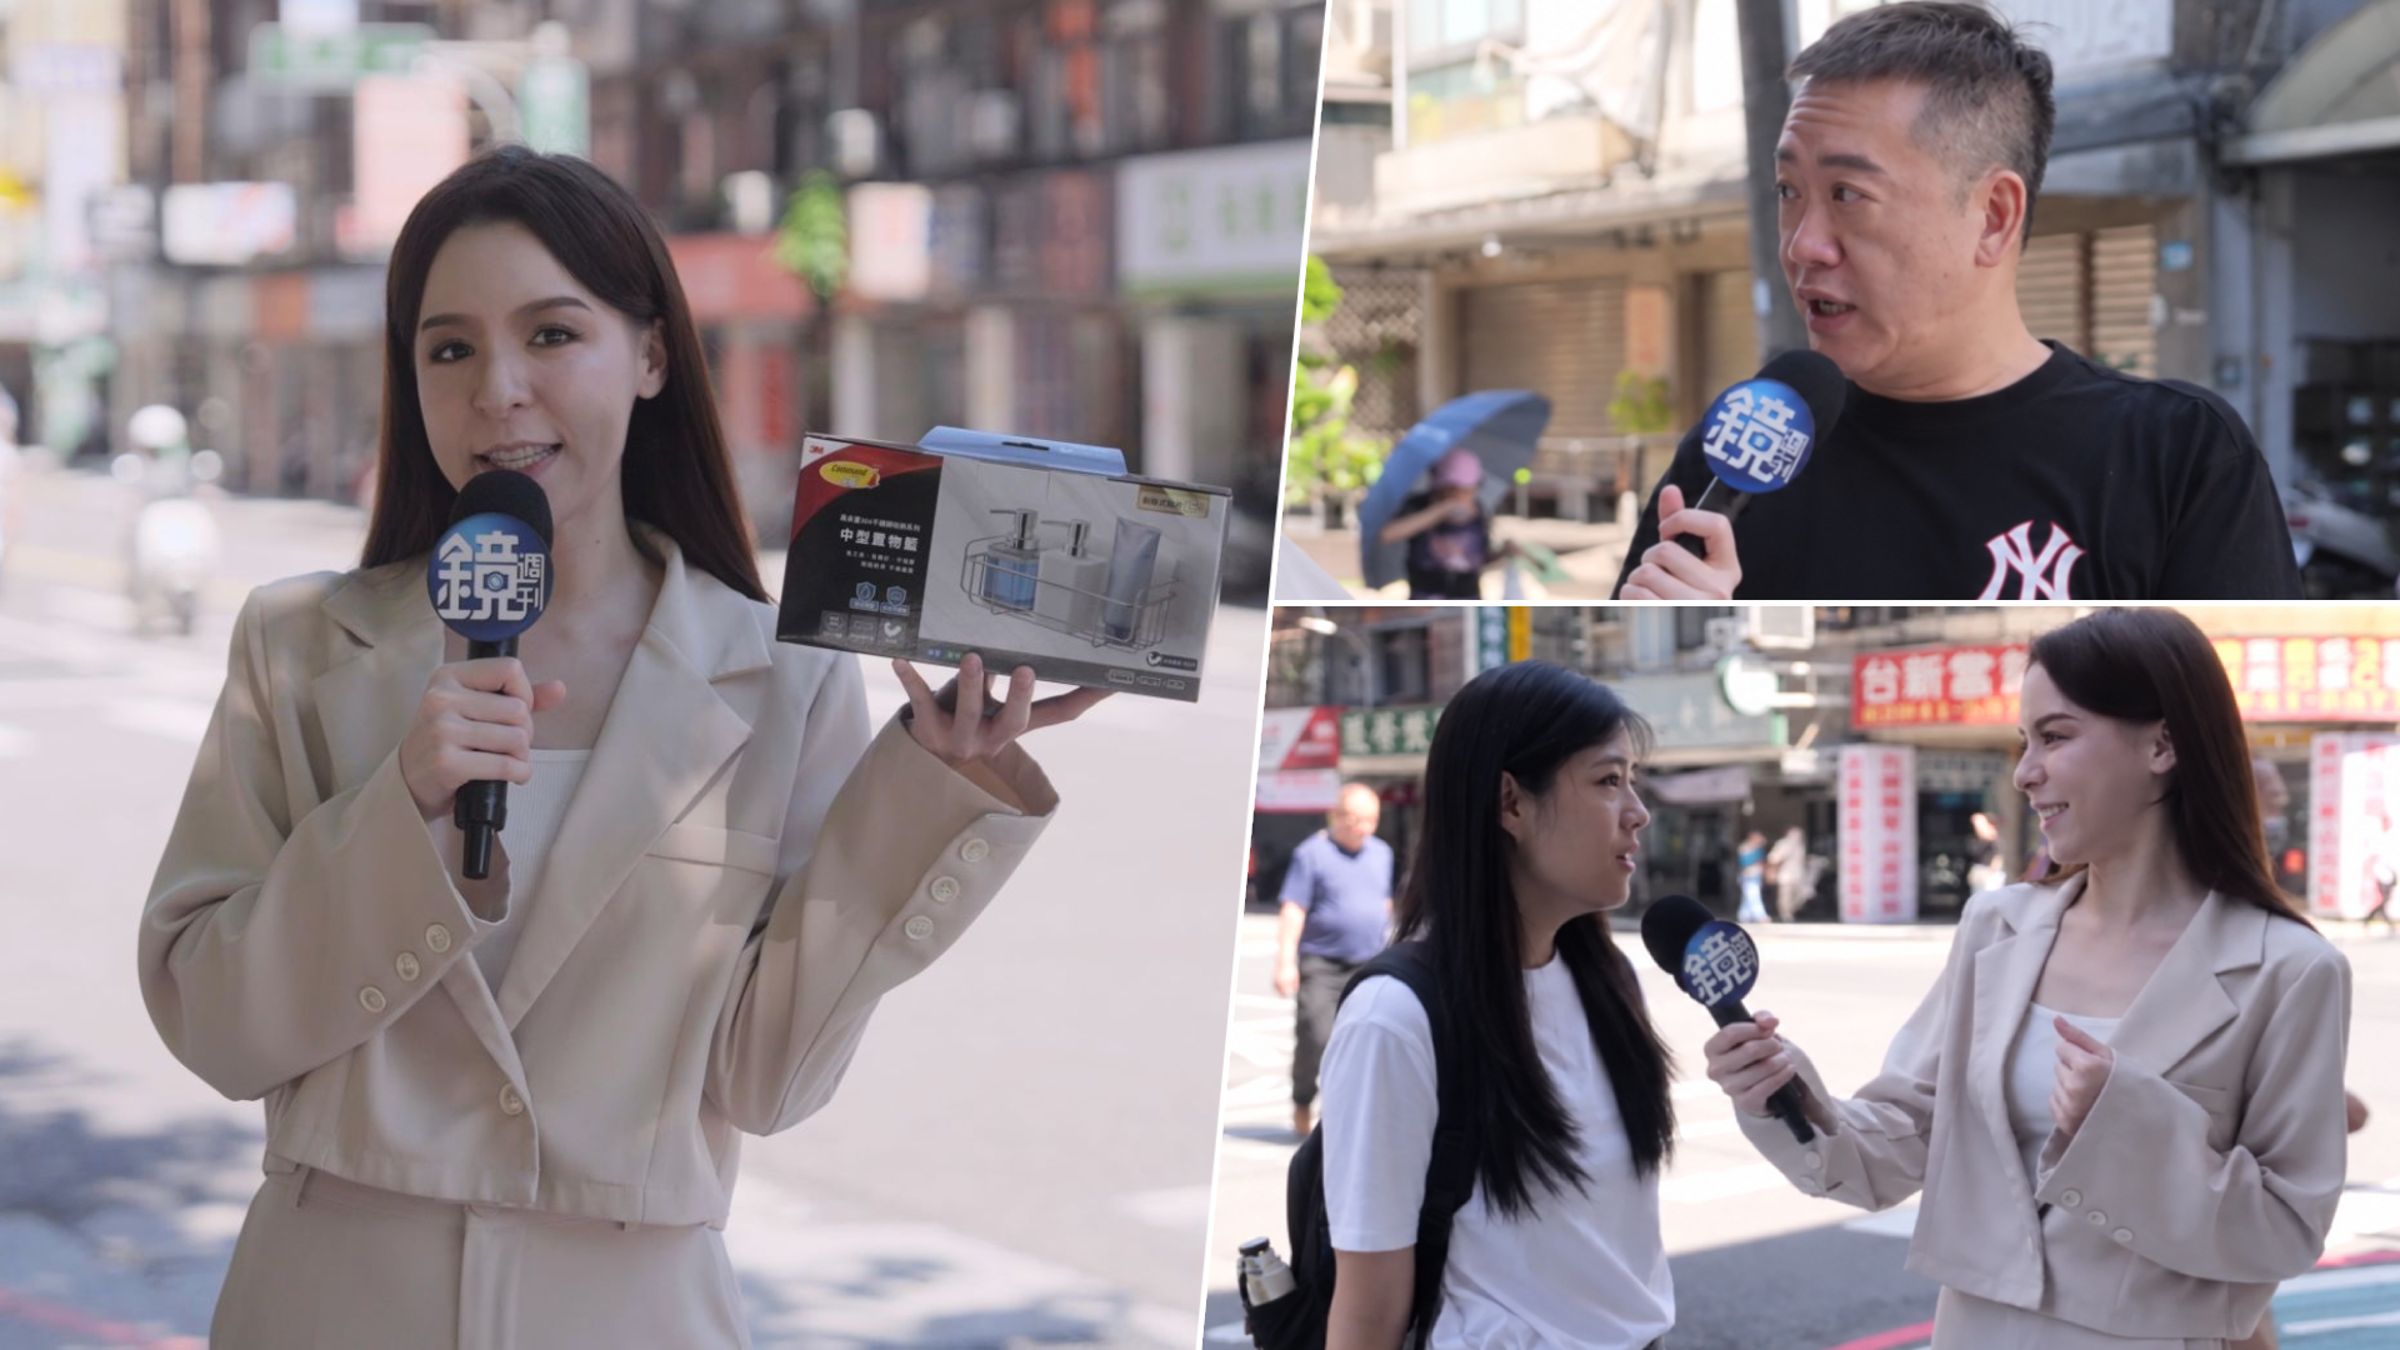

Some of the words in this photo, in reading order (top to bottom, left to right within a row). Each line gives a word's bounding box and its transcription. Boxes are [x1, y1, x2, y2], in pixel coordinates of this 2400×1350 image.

[831, 463, 869, 477] Command
[1703, 387, 1797, 484] 鏡
[437, 530, 528, 621] 鏡
[1976, 518, 2087, 600] NY
